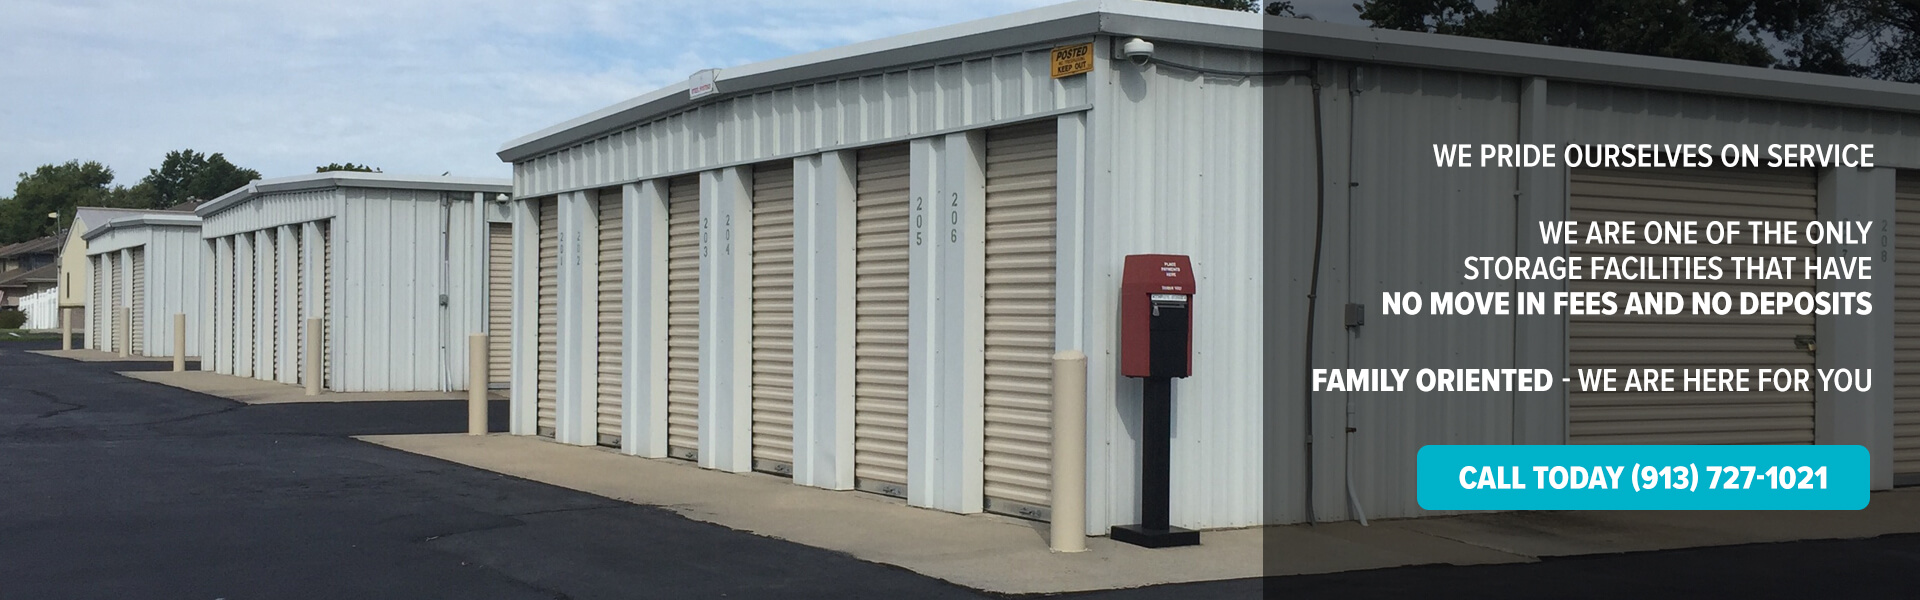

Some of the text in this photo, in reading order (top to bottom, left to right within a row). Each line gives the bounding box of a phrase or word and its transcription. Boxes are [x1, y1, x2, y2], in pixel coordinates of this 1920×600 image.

[1056, 46, 1088, 61] POSTED
[1057, 64, 1072, 73] KEEP
[1074, 61, 1087, 69] OUT
